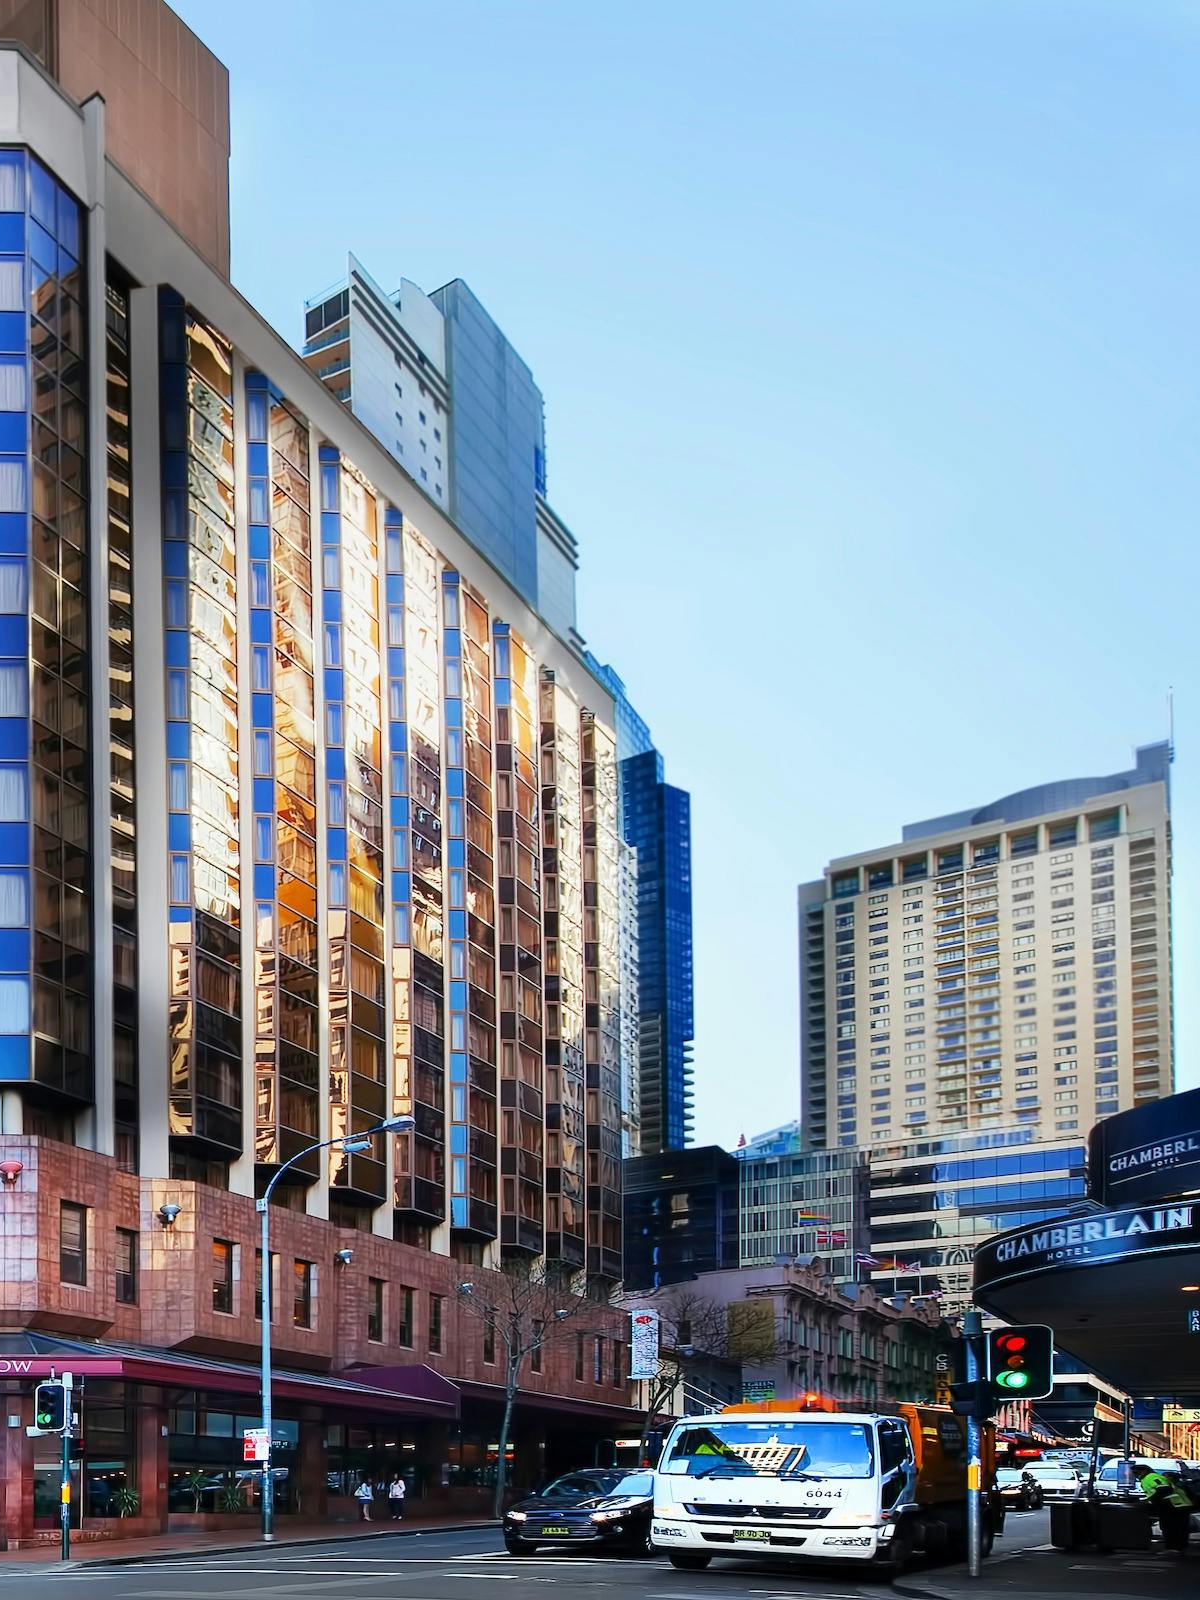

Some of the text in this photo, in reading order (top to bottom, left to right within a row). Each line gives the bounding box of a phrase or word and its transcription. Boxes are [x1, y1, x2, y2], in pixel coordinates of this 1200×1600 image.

[996, 1206, 1193, 1262] CHAMBERLAIN
[1047, 1246, 1091, 1261] HOTEL
[1191, 1310, 1200, 1331] BAR
[806, 1490, 842, 1498] 6044
